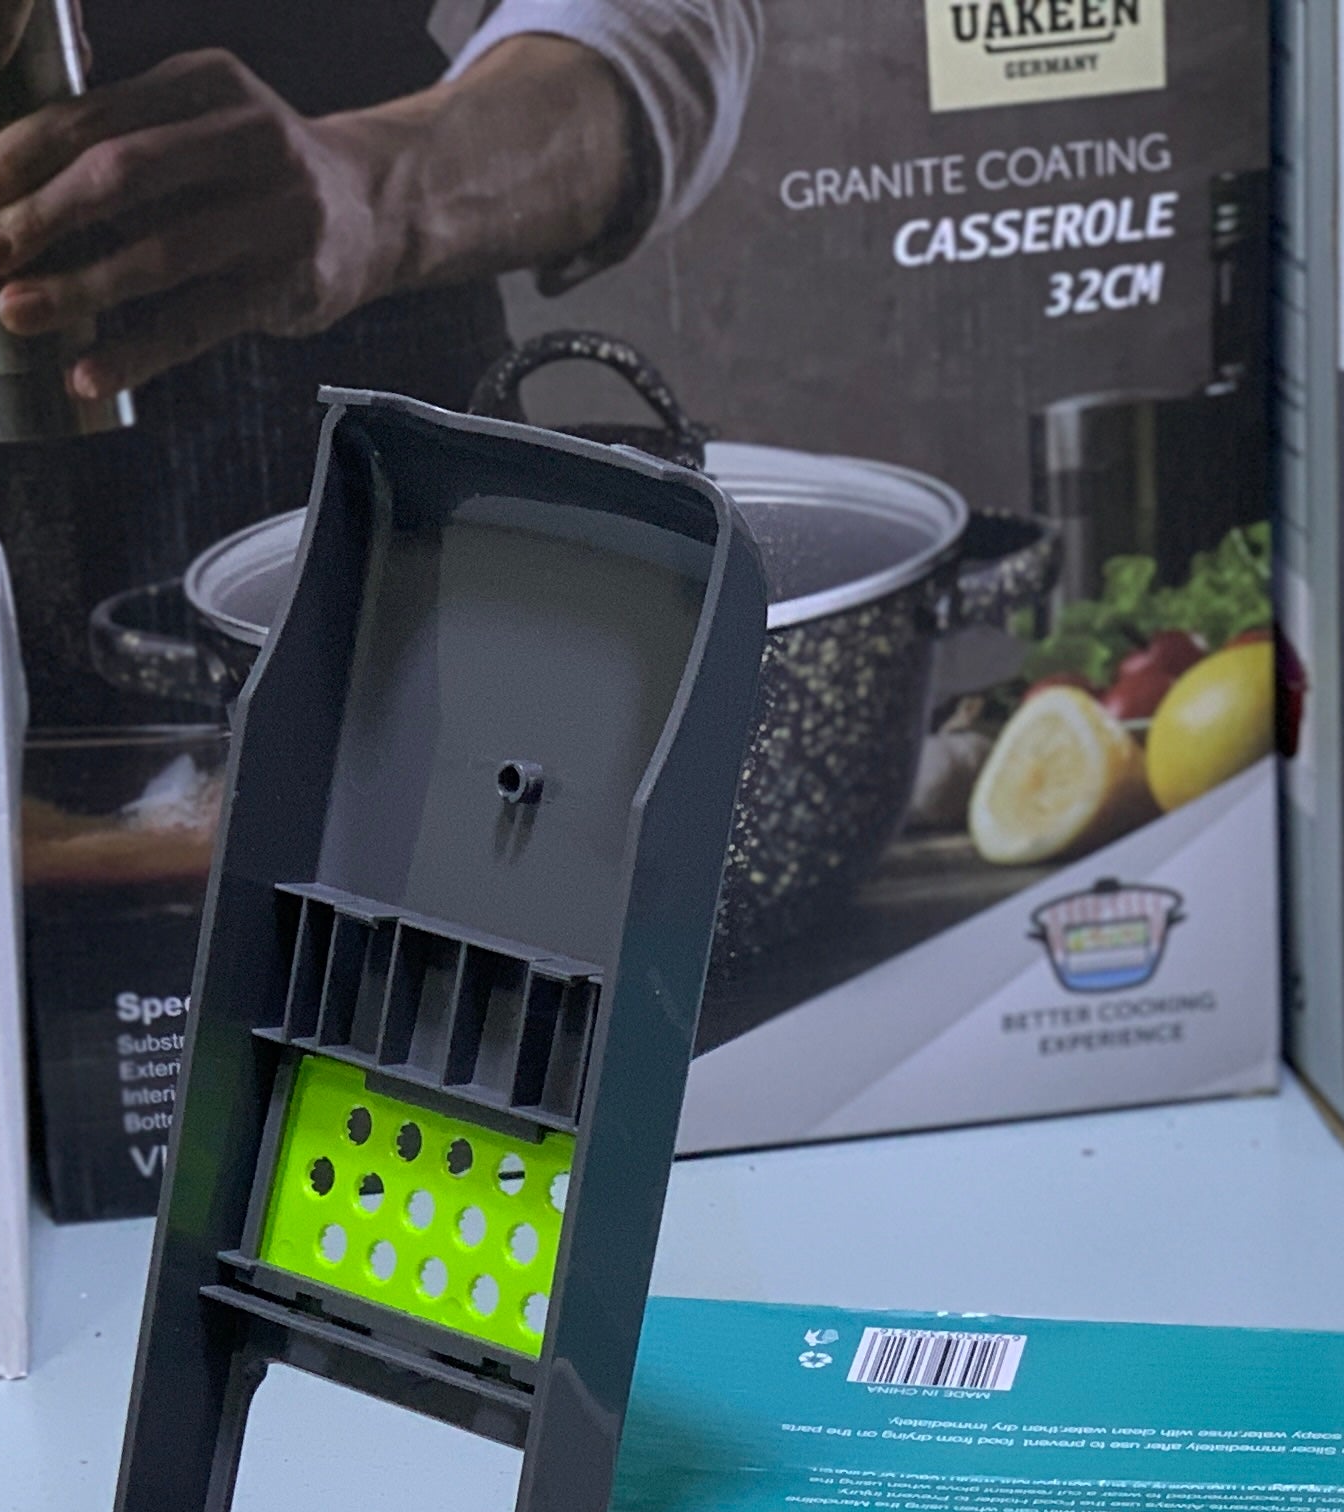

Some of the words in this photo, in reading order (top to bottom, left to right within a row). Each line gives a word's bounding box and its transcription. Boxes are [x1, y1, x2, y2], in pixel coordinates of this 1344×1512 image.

[951, 0, 1140, 42] UAKEEN
[1005, 54, 1099, 80] GERMANY
[780, 154, 965, 210] GRANITE
[977, 133, 1172, 190] COATING
[893, 192, 1179, 267] CASSEROLE
[1044, 261, 1165, 317] 32CM
[1001, 1003, 1093, 1033] BETTER
[1098, 991, 1217, 1020] COOKING
[1039, 1022, 1184, 1057] EXPERIENCE
[866, 1386, 917, 1395] CHINA
[922, 1388, 938, 1396] IN
[943, 1390, 990, 1399] MADE
[781, 1423, 822, 1433] parts
[992, 1422, 1017, 1431] dry
[1112, 1427, 1155, 1436] clean
[826, 1427, 851, 1437] the
[881, 1430, 932, 1441] drying
[1160, 1428, 1192, 1437] with
[1291, 1430, 1341, 1439] soapy
[936, 1435, 972, 1444] from
[978, 1436, 1013, 1445] food
[1023, 1437, 1085, 1447] prevent
[1144, 1442, 1181, 1450] after
[1185, 1443, 1285, 1453] immediately
[1289, 1445, 1336, 1454] Slicer
